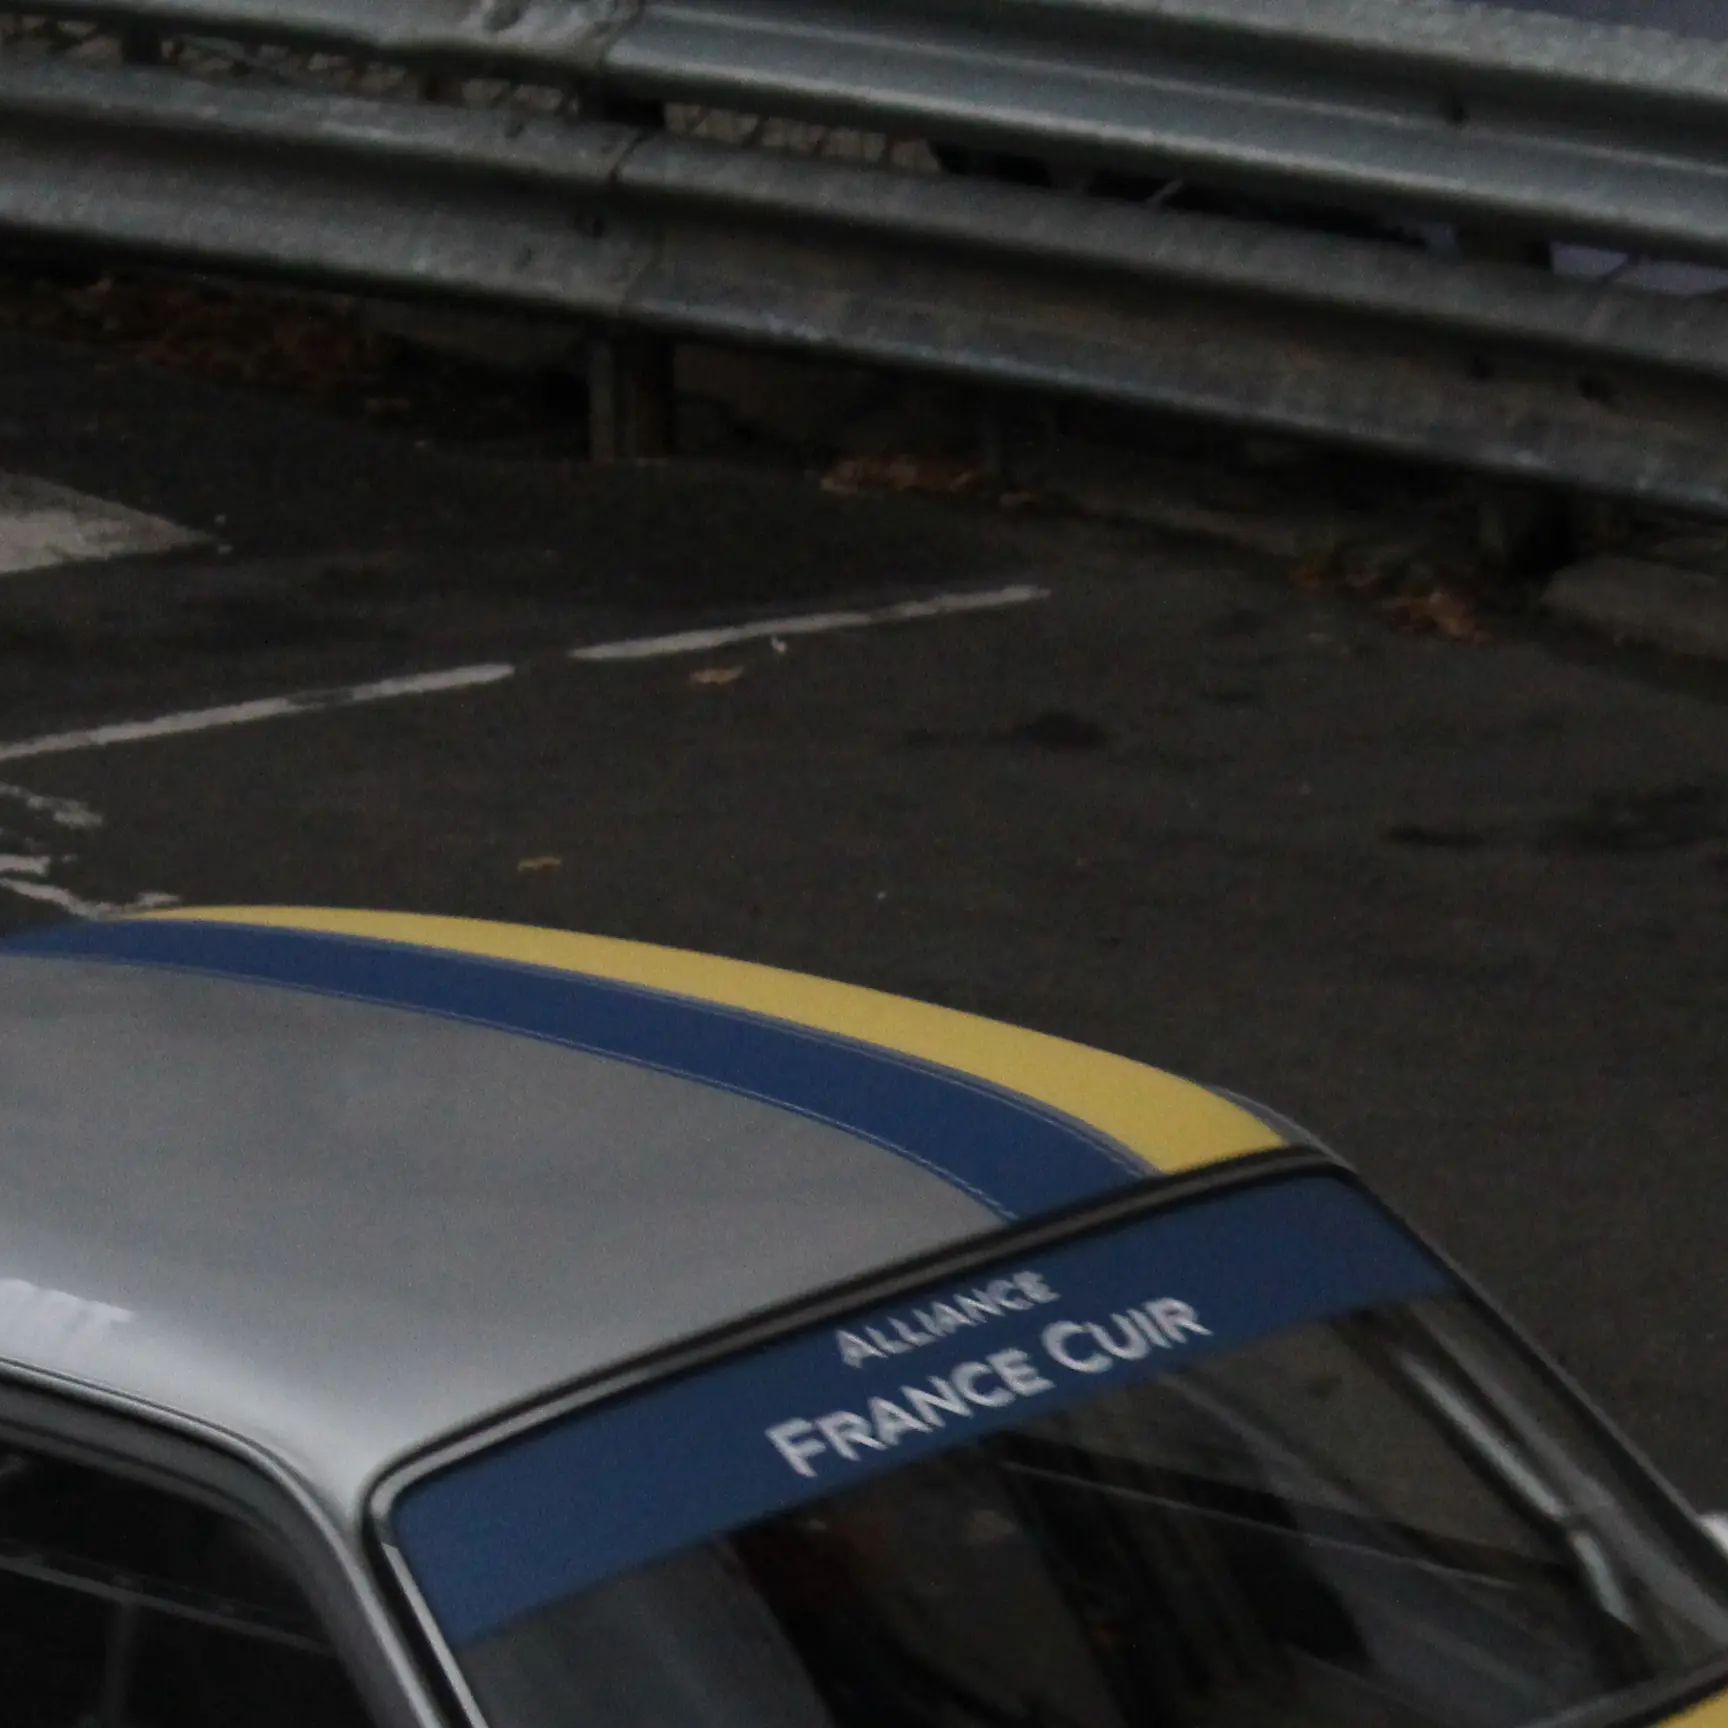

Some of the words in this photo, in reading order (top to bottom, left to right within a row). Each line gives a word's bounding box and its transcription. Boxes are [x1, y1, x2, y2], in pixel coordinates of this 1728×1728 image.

[764, 1345, 1057, 1479] FRANCE
[1040, 1296, 1215, 1374] CUIR
[834, 1269, 1061, 1369] ALLIANCE
